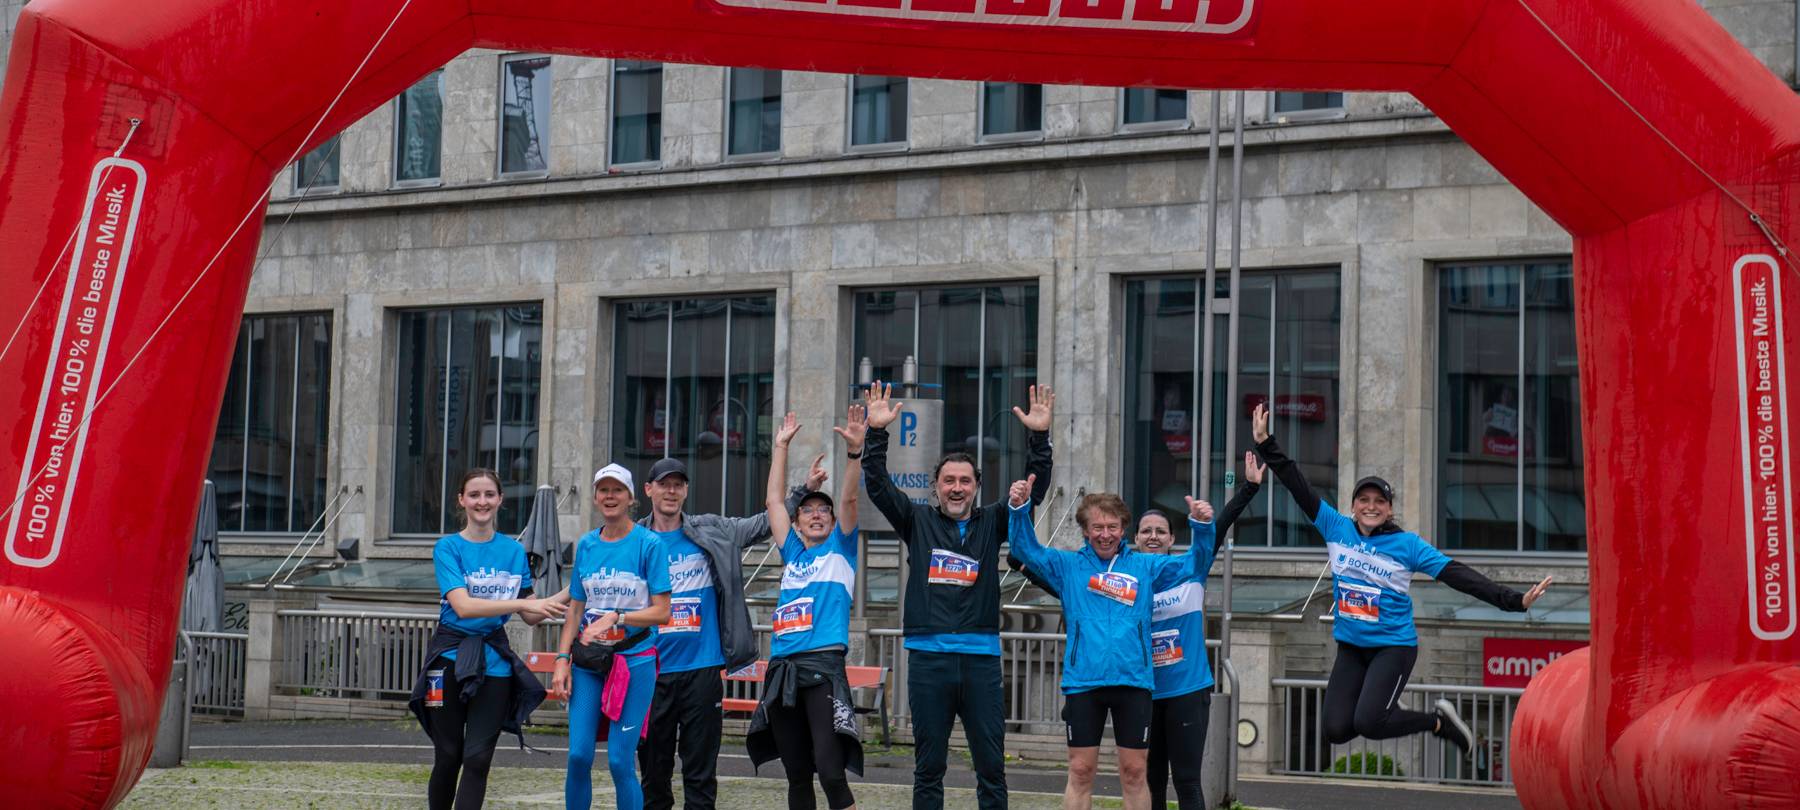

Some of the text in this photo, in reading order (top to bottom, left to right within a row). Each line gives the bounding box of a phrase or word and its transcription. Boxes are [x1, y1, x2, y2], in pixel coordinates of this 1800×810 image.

[25, 183, 127, 542] 100% von hier. 100% die beste Musik.
[1750, 276, 1782, 619] 100% von hier. 100% die beste Musik.
[889, 472, 929, 489] KASSE
[669, 567, 704, 582] OCHUM
[1348, 557, 1393, 579] BOCHUM
[472, 585, 515, 594] BOCHUM
[592, 585, 637, 597] BOCHUM
[1152, 595, 1181, 609] CHUM
[1487, 651, 1562, 678] amp
